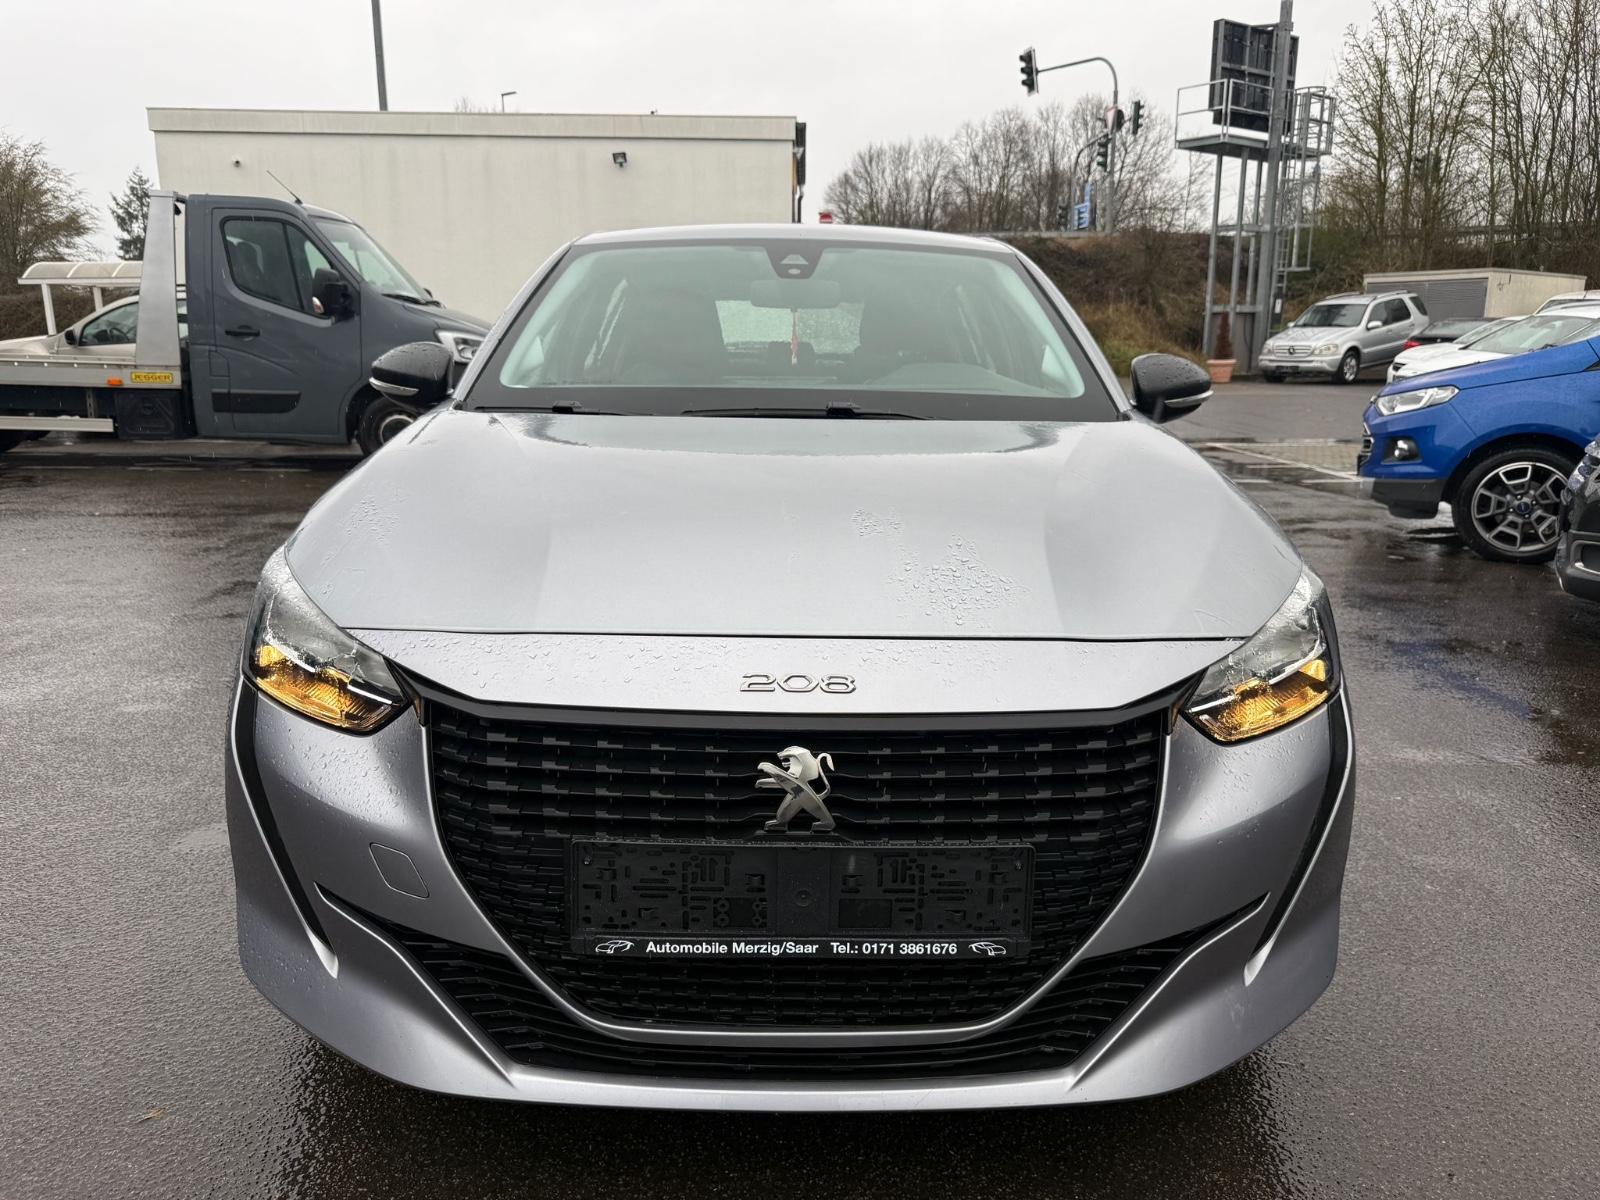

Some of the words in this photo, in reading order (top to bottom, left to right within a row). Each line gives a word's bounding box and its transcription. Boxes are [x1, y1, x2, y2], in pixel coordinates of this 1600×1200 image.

[740, 674, 857, 694] 208
[646, 941, 728, 954] Automobile
[732, 942, 819, 956] Merzig/Saar
[830, 942, 858, 954] Tel.:
[862, 943, 894, 954] 0171
[899, 943, 958, 955] 3861676
